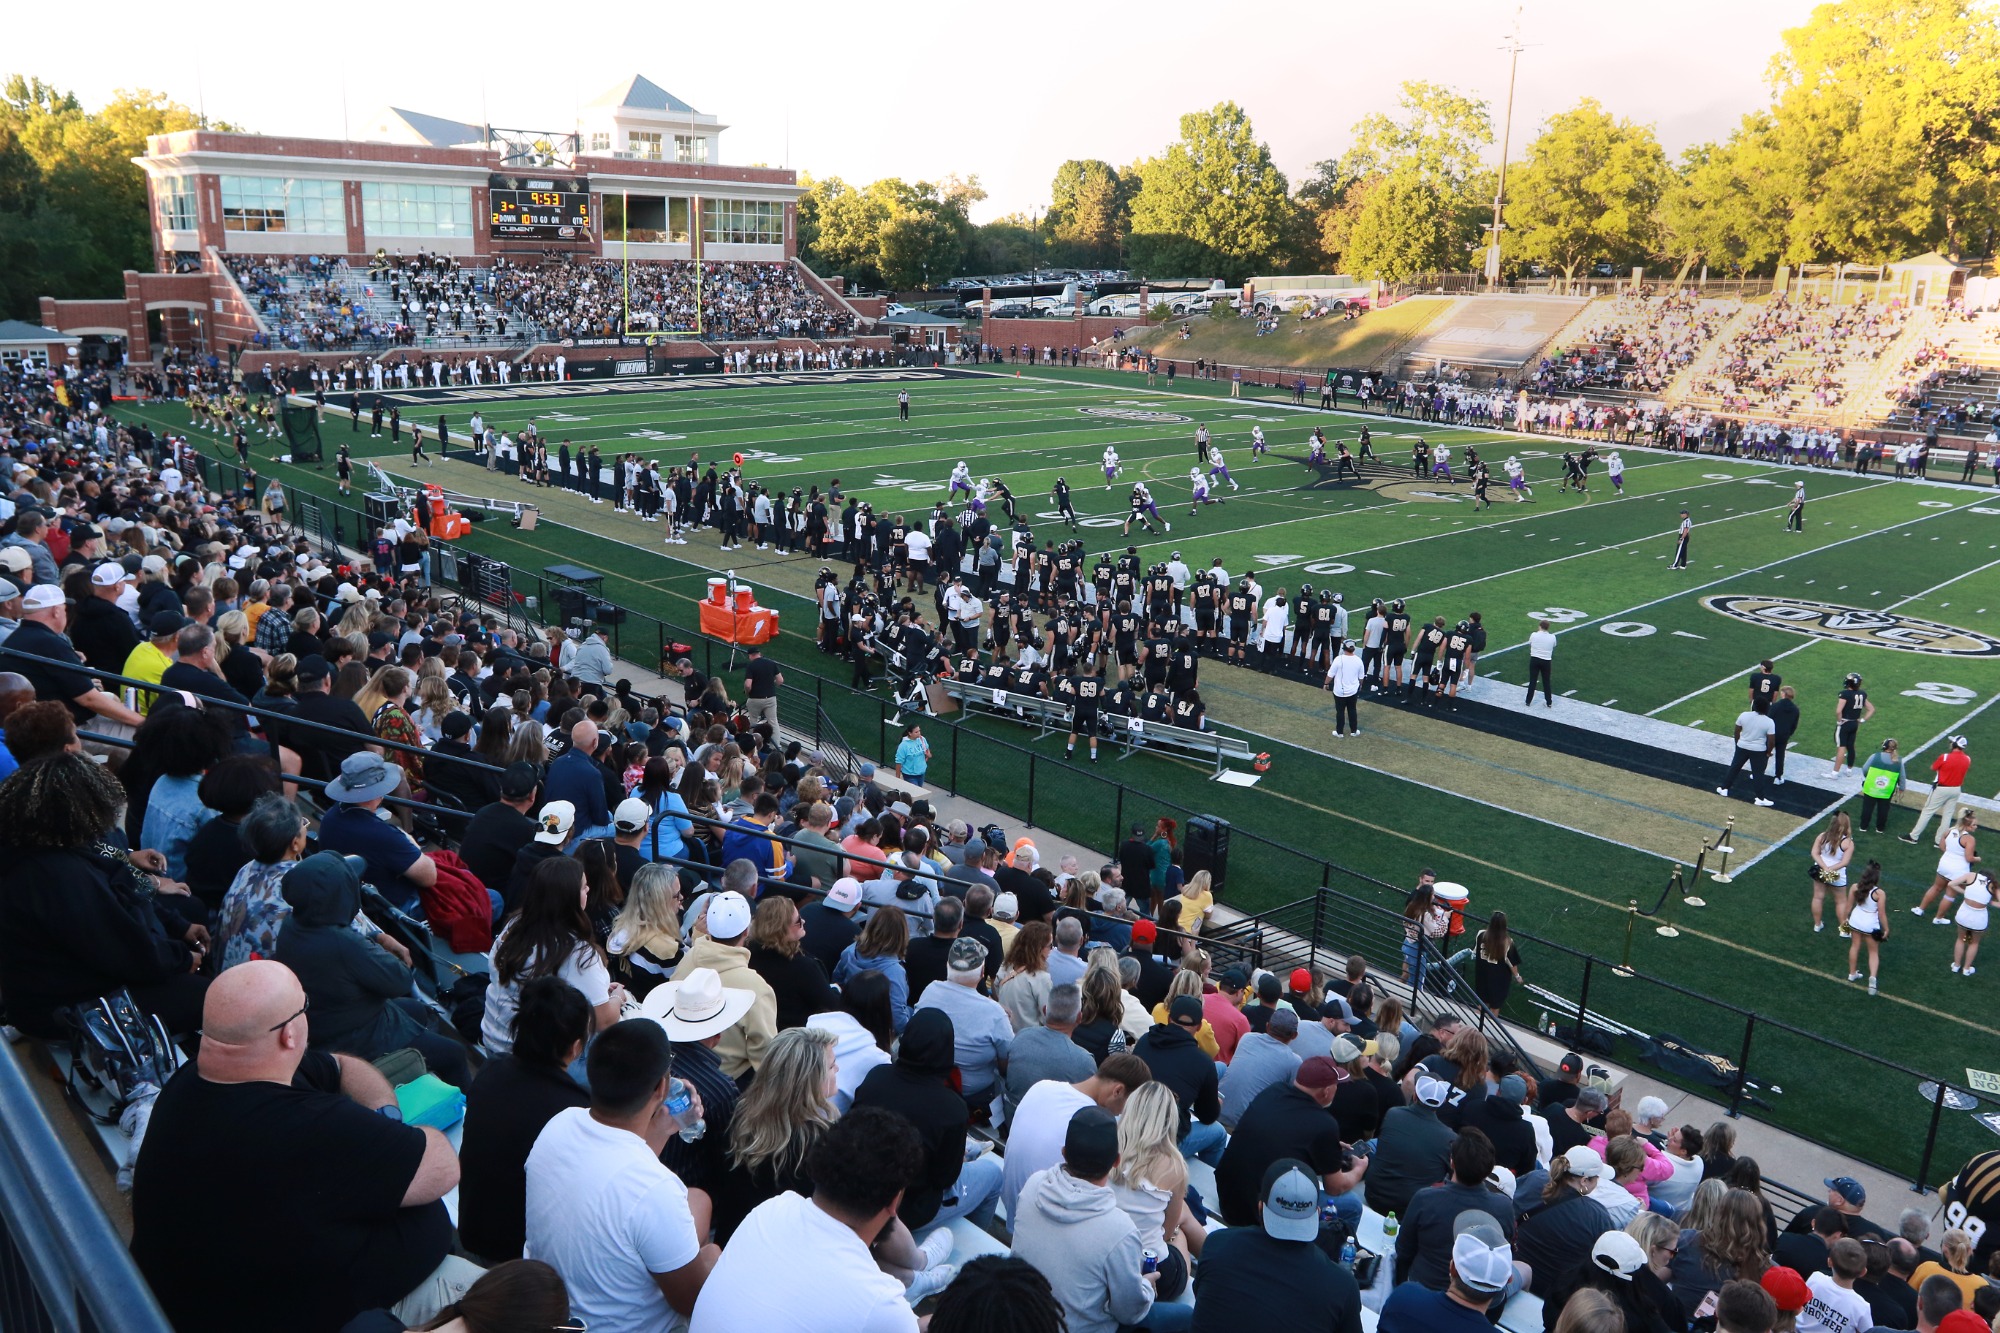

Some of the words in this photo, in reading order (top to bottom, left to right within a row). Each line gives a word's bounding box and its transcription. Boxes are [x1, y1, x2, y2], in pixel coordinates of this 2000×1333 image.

[531, 192, 560, 206] 9:53
[500, 201, 508, 212] 3
[579, 204, 587, 215] 6
[492, 213, 499, 224] 2
[499, 214, 517, 223] DOWN
[521, 214, 530, 225] 10
[531, 215, 538, 223] TO
[539, 215, 548, 223] GO
[551, 216, 560, 224] ON
[583, 216, 589, 227] 2
[1061, 485, 1067, 494] 1
[1038, 553, 1049, 566] 72
[1059, 558, 1072, 571] 65
[1097, 567, 1111, 580] 35
[1116, 573, 1130, 586] 22
[1299, 601, 1309, 614] 5
[1122, 618, 1135, 632] 94
[1164, 619, 1178, 633] 47
[1392, 618, 1407, 632] 80
[1155, 643, 1169, 659] 92
[960, 659, 974, 673] 23
[1079, 681, 1097, 697] 69
[1760, 678, 1771, 693] 6
[1113, 691, 1123, 704] 4
[1147, 694, 1158, 709] 6
[1972, 1071, 2000, 1084] MA
[1808, 1297, 1849, 1326] IONETTE
